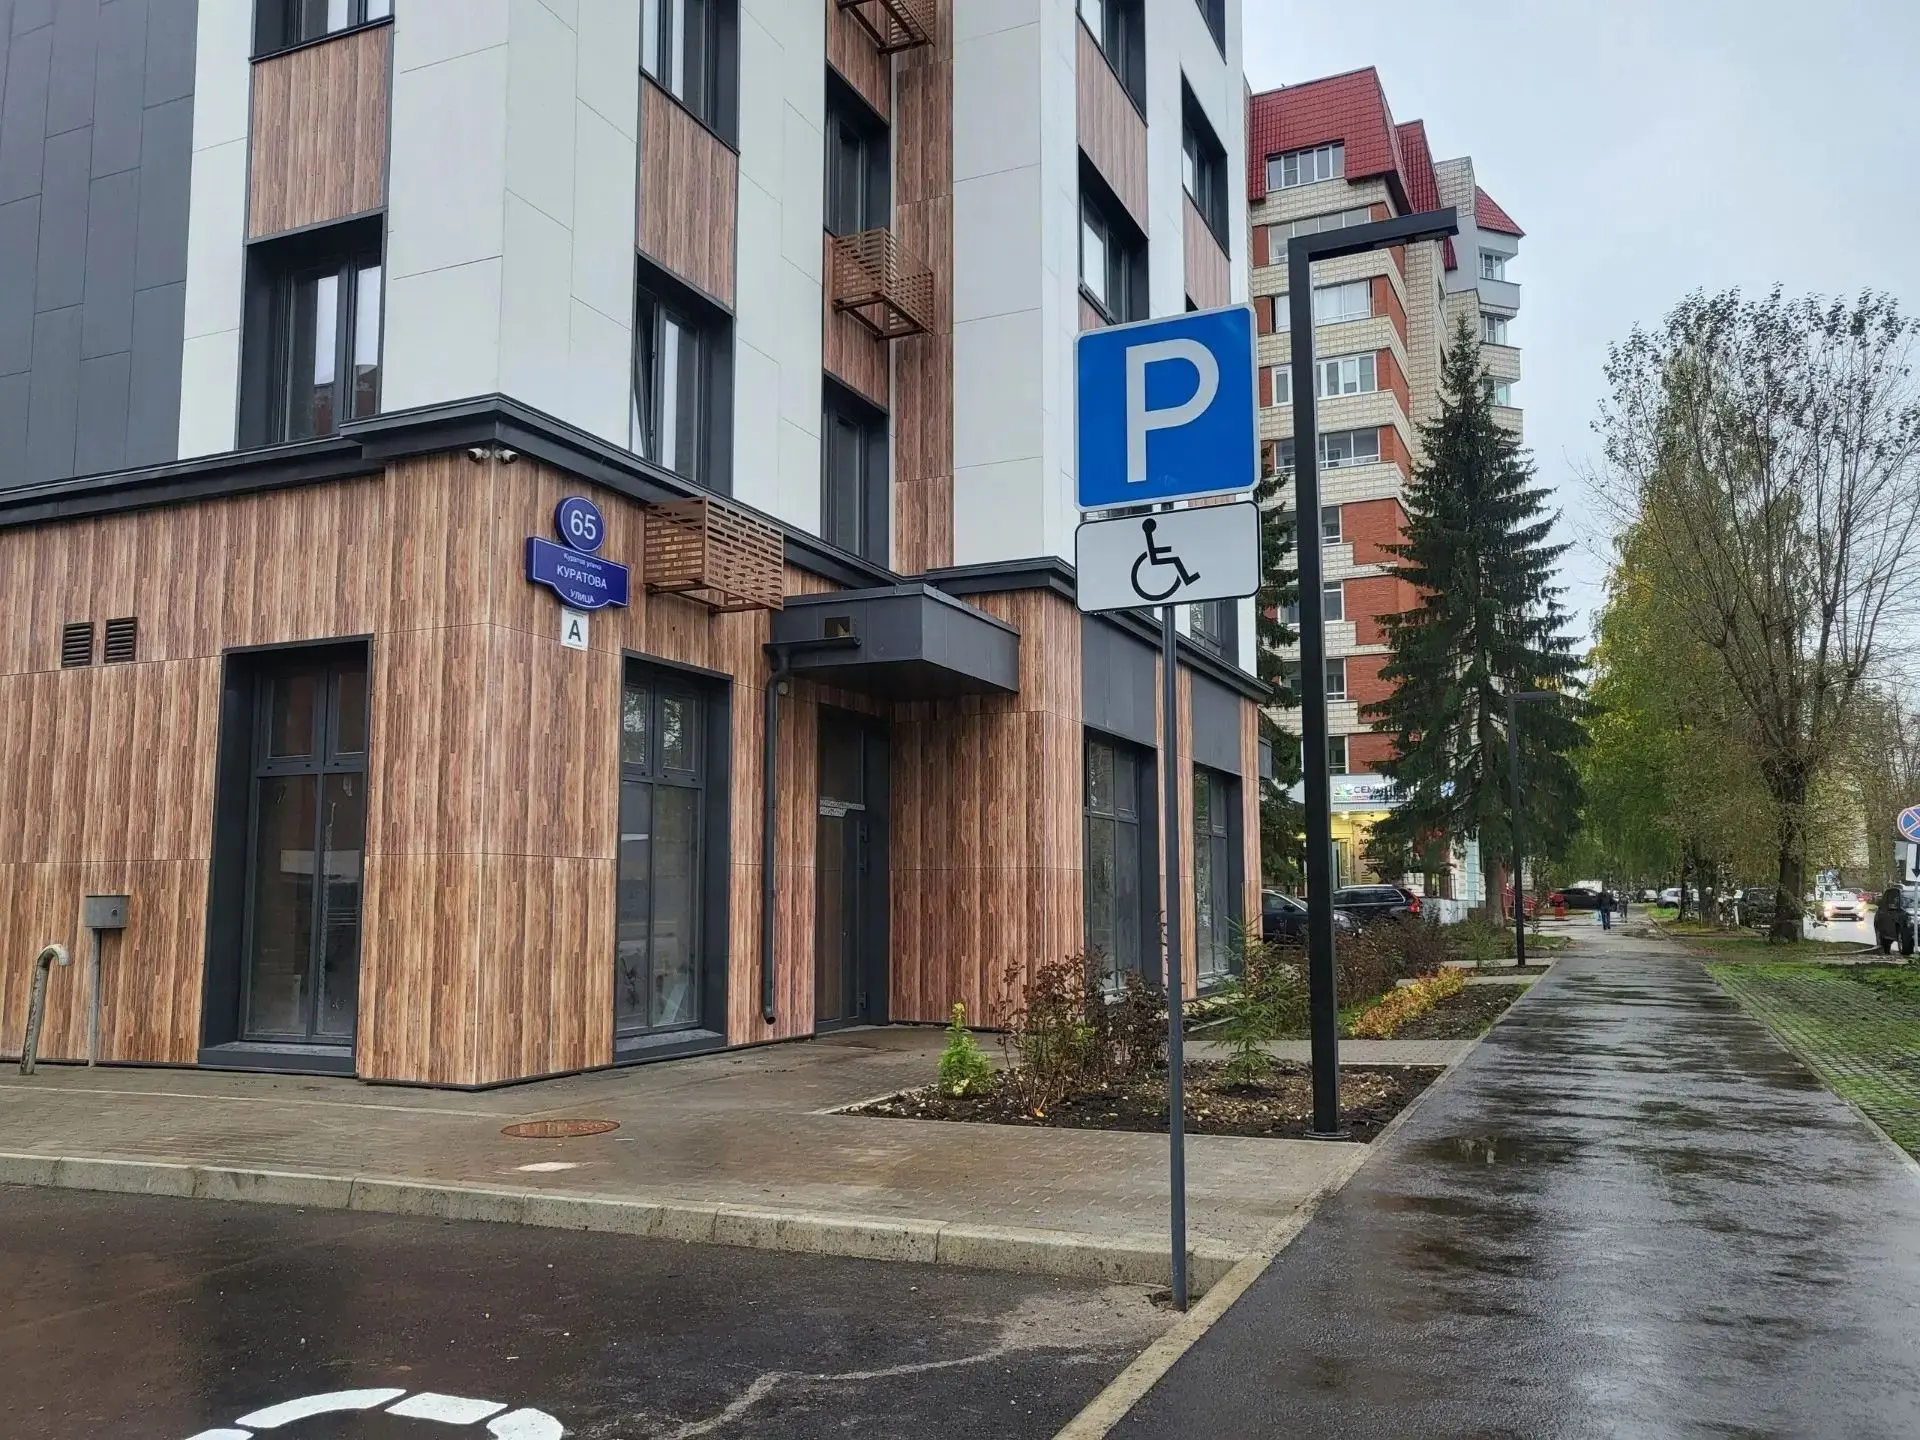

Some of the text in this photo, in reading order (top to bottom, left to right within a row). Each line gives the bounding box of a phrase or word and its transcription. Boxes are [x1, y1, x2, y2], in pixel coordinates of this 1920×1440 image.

[1125, 338, 1220, 483] P
[570, 509, 596, 540] 65
[556, 564, 608, 590] КУРАТОВА
[570, 589, 595, 603] УЛИЦА
